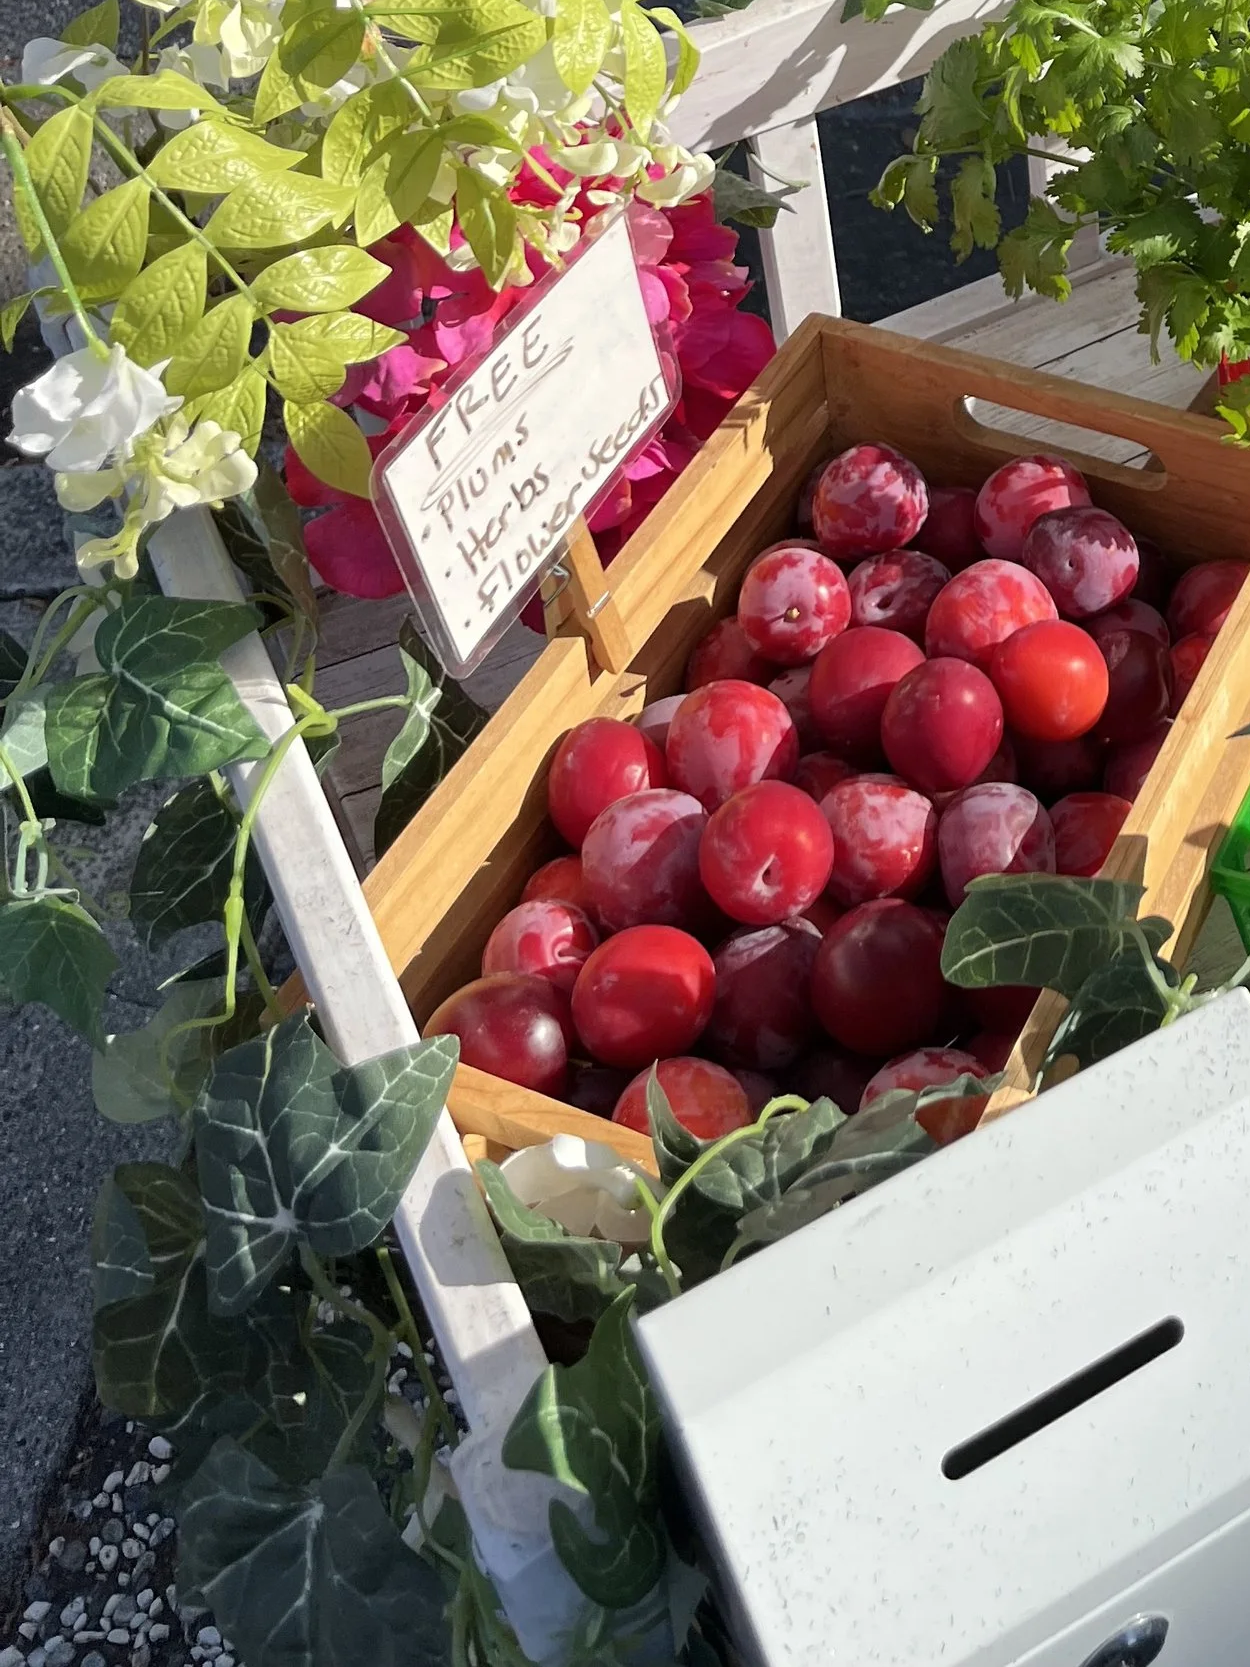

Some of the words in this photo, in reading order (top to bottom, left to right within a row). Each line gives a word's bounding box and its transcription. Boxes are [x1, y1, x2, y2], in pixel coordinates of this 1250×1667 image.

[425, 314, 549, 472] FREE
[436, 410, 530, 533] Plums
[457, 462, 551, 576] Herbs
